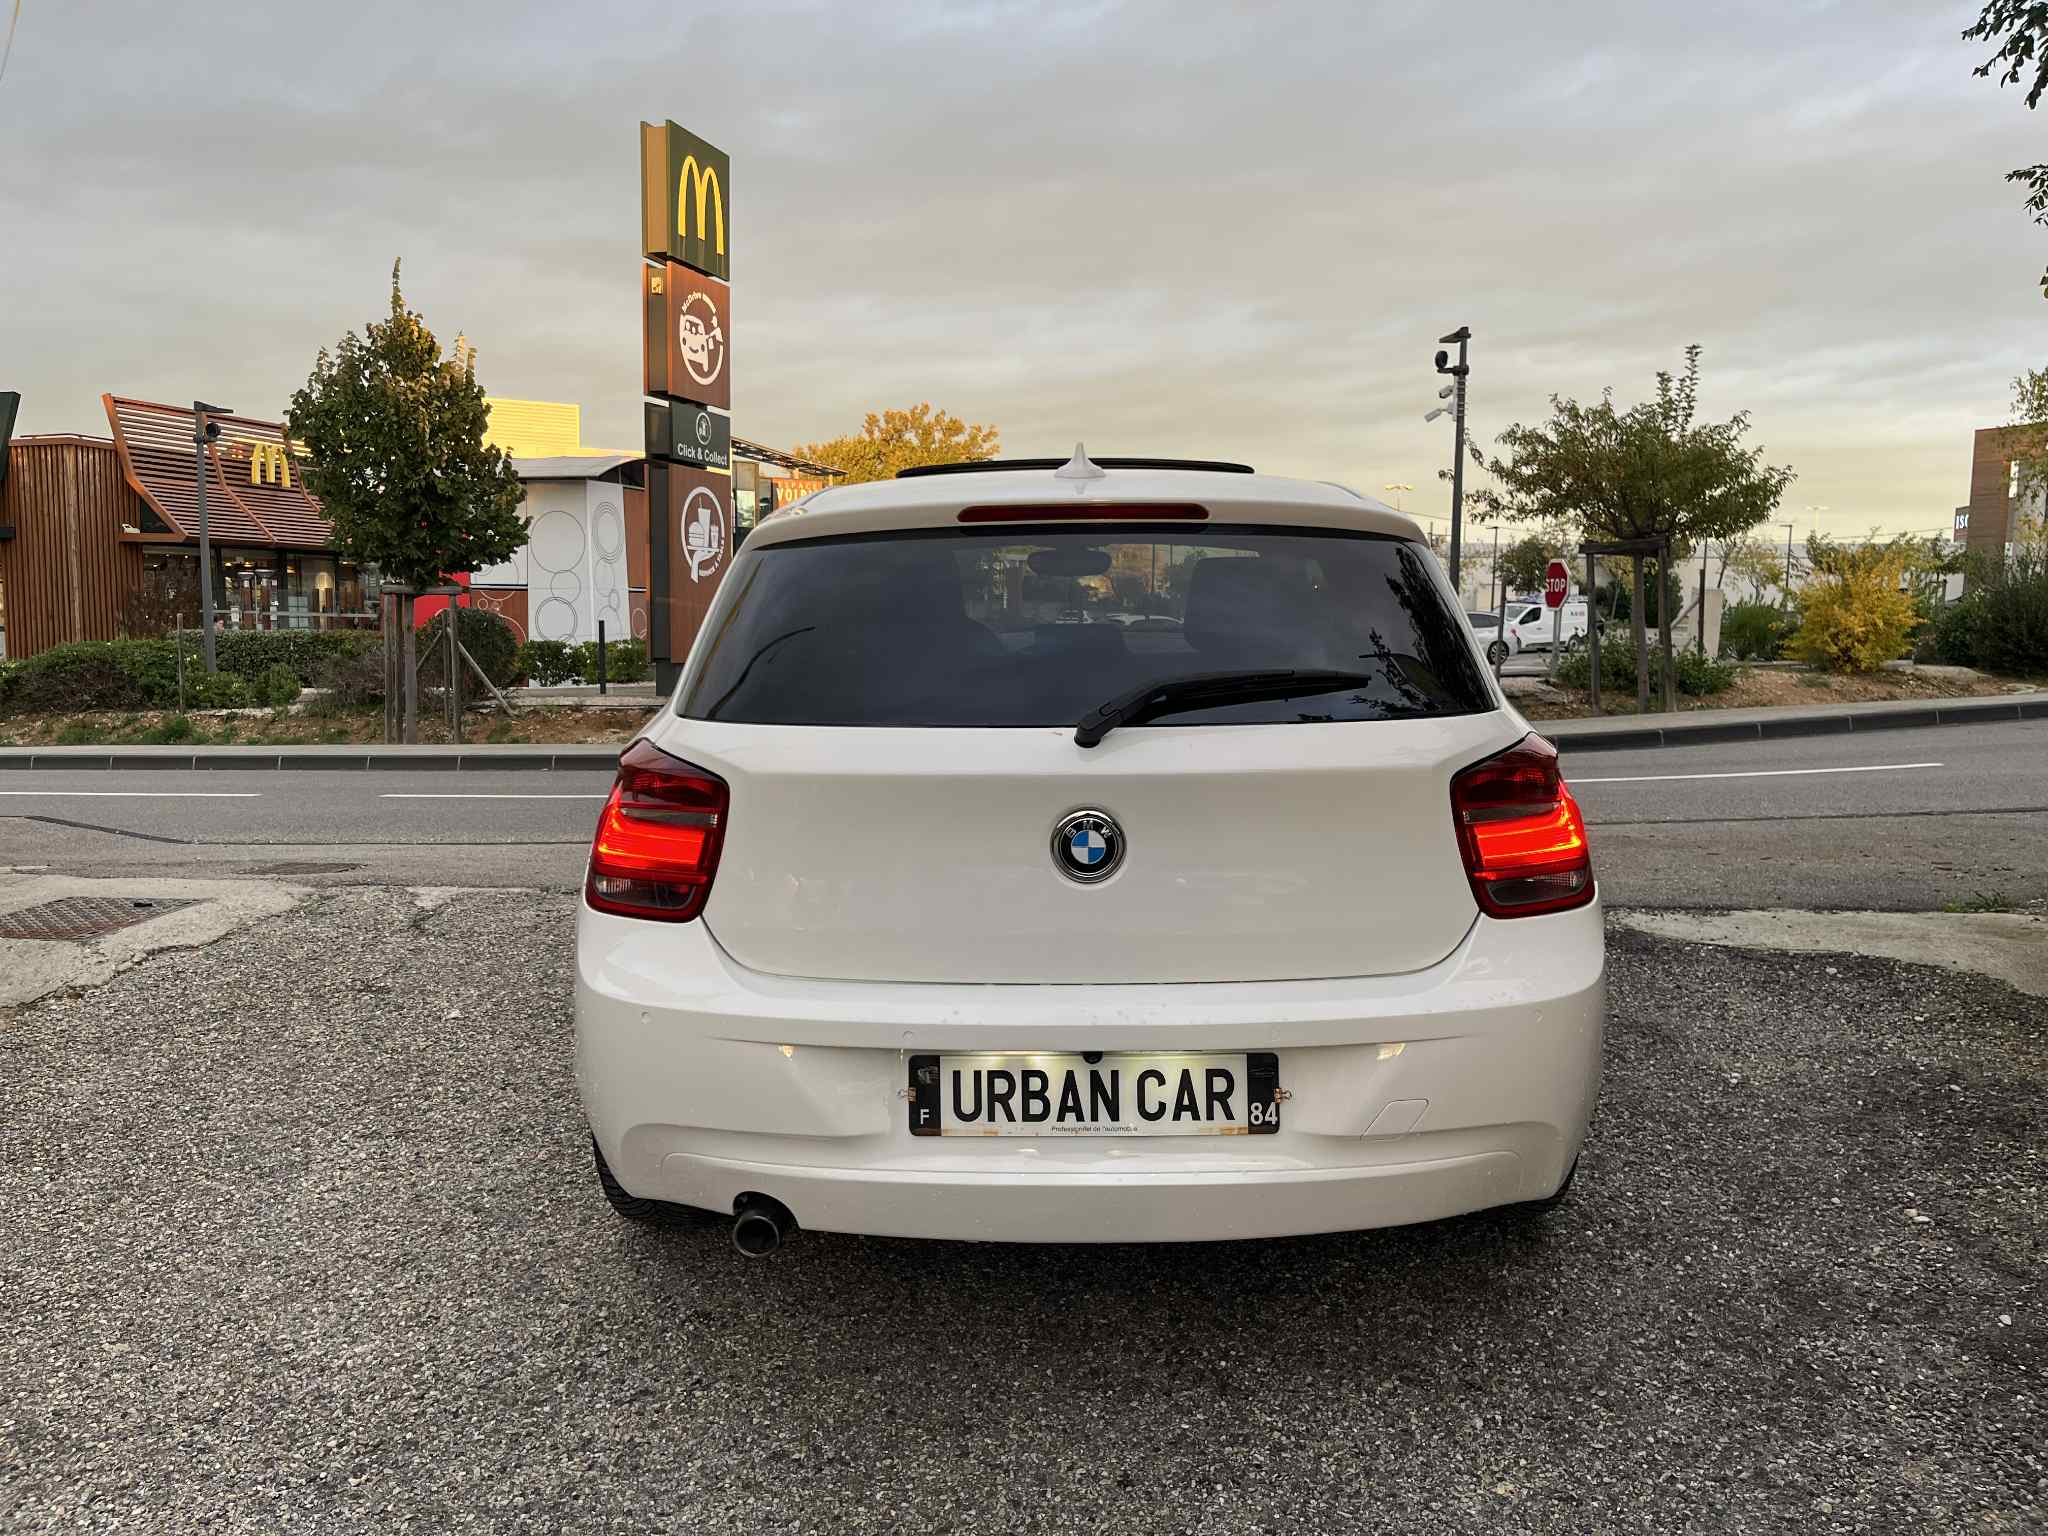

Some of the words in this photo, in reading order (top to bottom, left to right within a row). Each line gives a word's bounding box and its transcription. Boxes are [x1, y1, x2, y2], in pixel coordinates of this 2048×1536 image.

[677, 443, 696, 459] Click
[697, 447, 703, 460] &
[704, 449, 728, 465] Collect
[1545, 578, 1566, 593] STOP
[1066, 820, 1112, 838] BMW
[952, 1069, 1120, 1123] URBAN
[1136, 1068, 1235, 1122] CAR
[920, 1108, 930, 1125] F
[1250, 1102, 1278, 1125] 84
